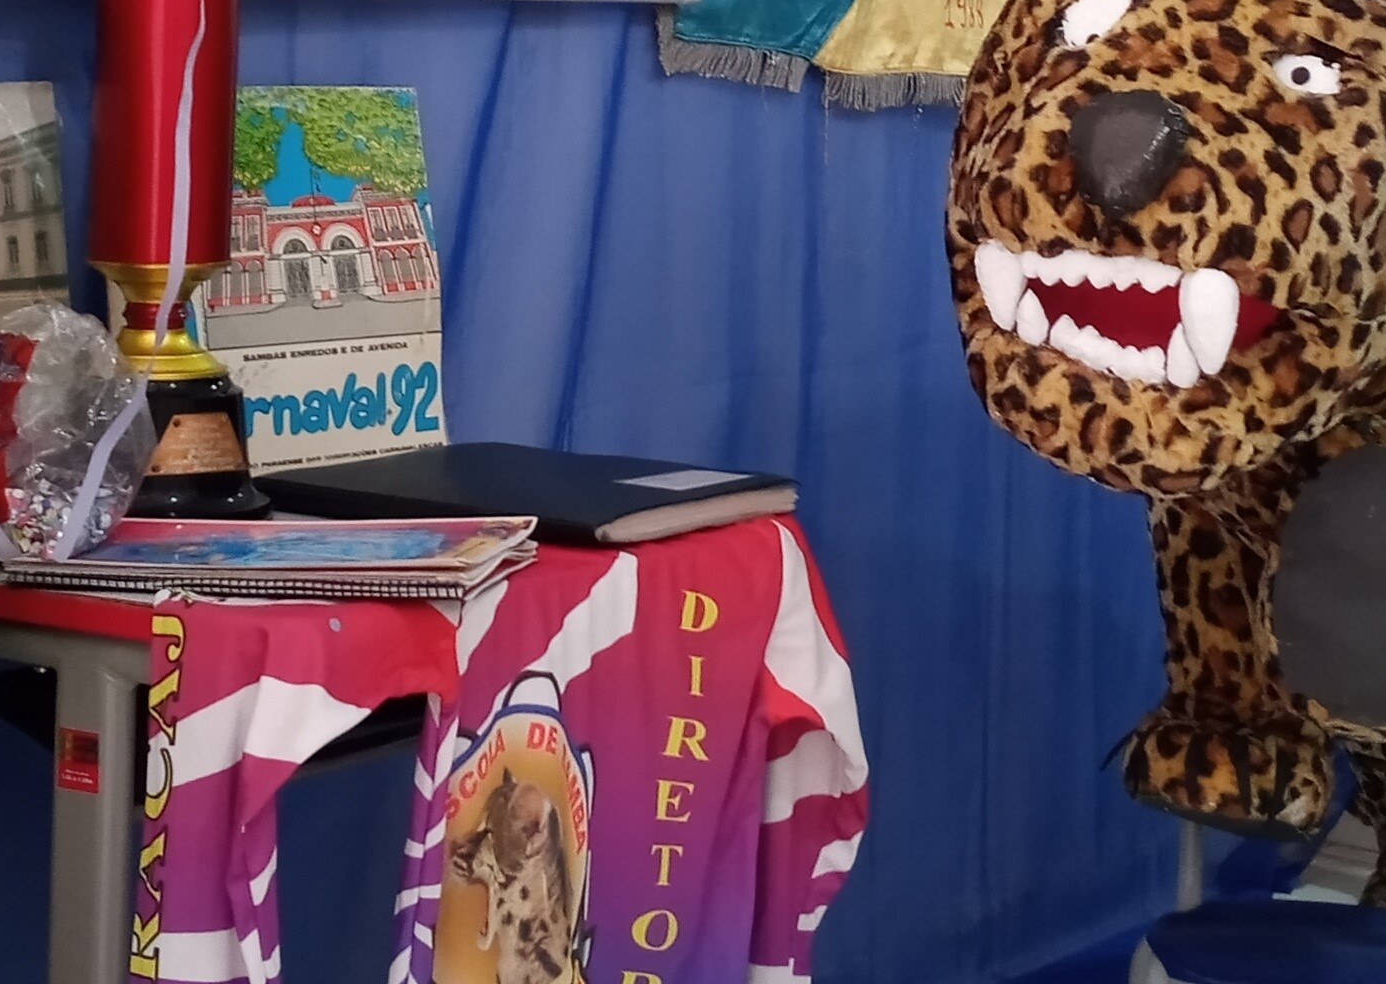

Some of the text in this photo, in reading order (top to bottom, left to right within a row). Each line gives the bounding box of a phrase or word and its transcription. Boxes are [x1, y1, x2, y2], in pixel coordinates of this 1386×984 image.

[391, 361, 440, 436] 92
[446, 722, 558, 821] SCOLA DE
[620, 589, 720, 984] DIRETO
